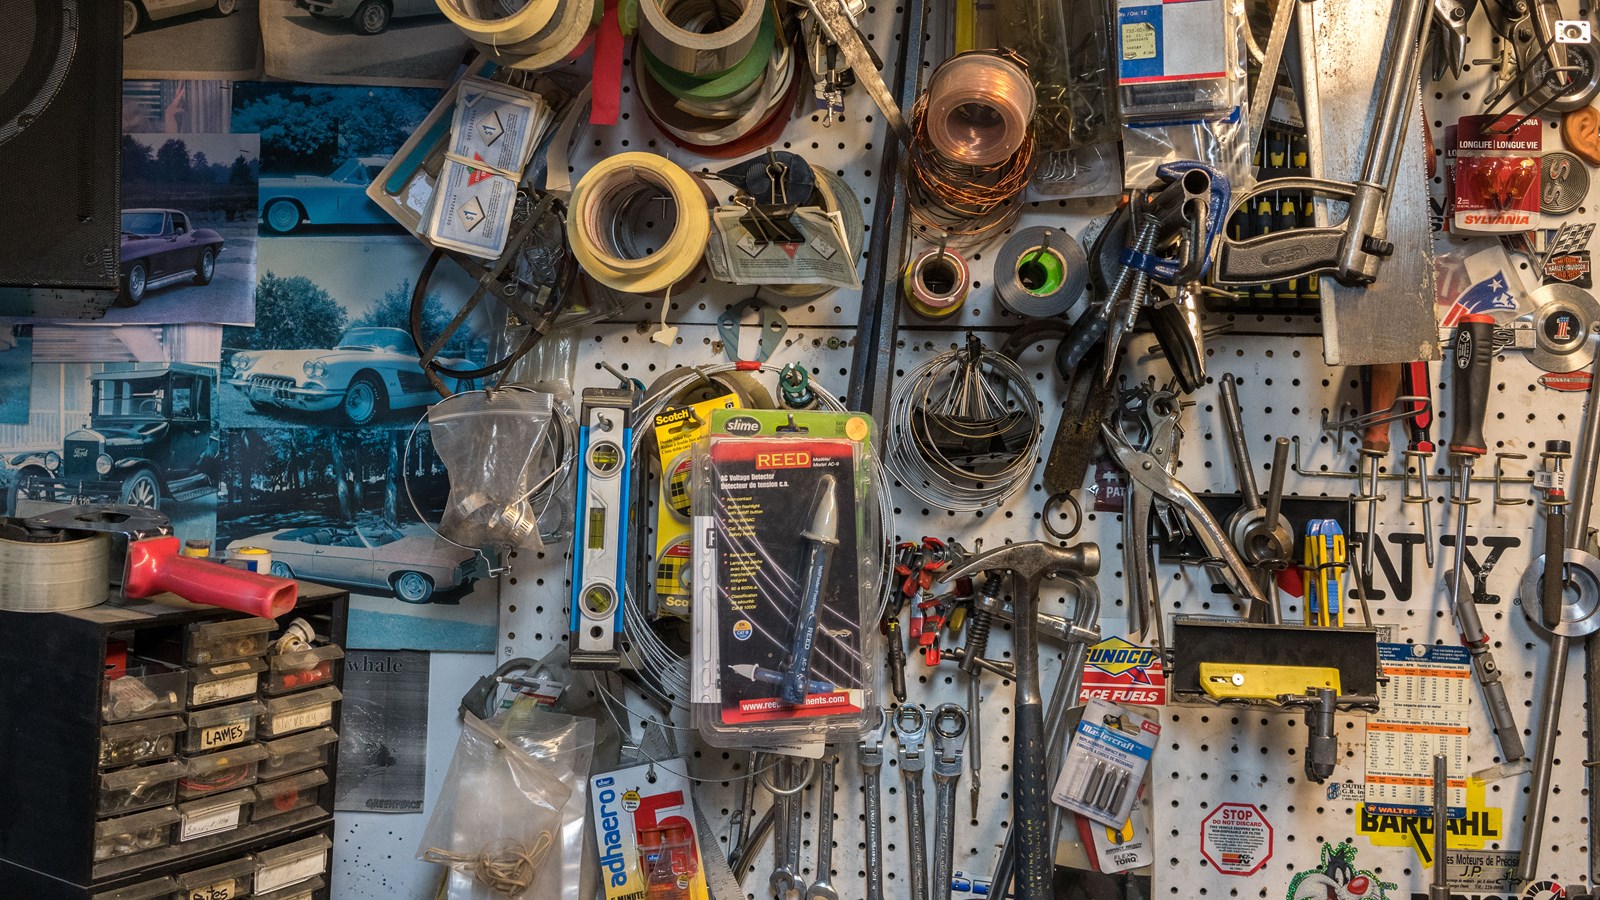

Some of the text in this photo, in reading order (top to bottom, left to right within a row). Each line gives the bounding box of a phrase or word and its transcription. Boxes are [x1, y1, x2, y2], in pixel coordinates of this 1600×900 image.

[482, 124, 496, 136] $1
[1460, 141, 1492, 149] LONGLIFE
[1497, 141, 1525, 149] LONGUE
[464, 210, 478, 221] $1
[1464, 215, 1529, 225] SYLVANIA
[656, 408, 689, 424] Scotch
[727, 419, 759, 432] slime
[73, 448, 88, 457] Ford
[758, 454, 810, 467] REED
[729, 474, 750, 482] Voltage
[721, 482, 748, 490] Détecteur
[804, 627, 814, 650] REED
[1086, 648, 1152, 664] SUNOCO
[347, 656, 403, 673] whale
[1080, 690, 1158, 702] ACE FUELS
[206, 724, 244, 745] LAMES
[1082, 724, 1135, 751] Mastercraft
[1104, 745, 1118, 755] IMPACT
[366, 799, 423, 810] GREENPEACE
[1223, 809, 1252, 820] STOP
[1378, 807, 1417, 815] WALTER
[599, 789, 627, 888] adhaero
[1115, 857, 1136, 866] TORQ
[1456, 854, 1483, 866] Moteurs
[1486, 855, 1493, 866] de
[1460, 866, 1482, 877] J.P.
